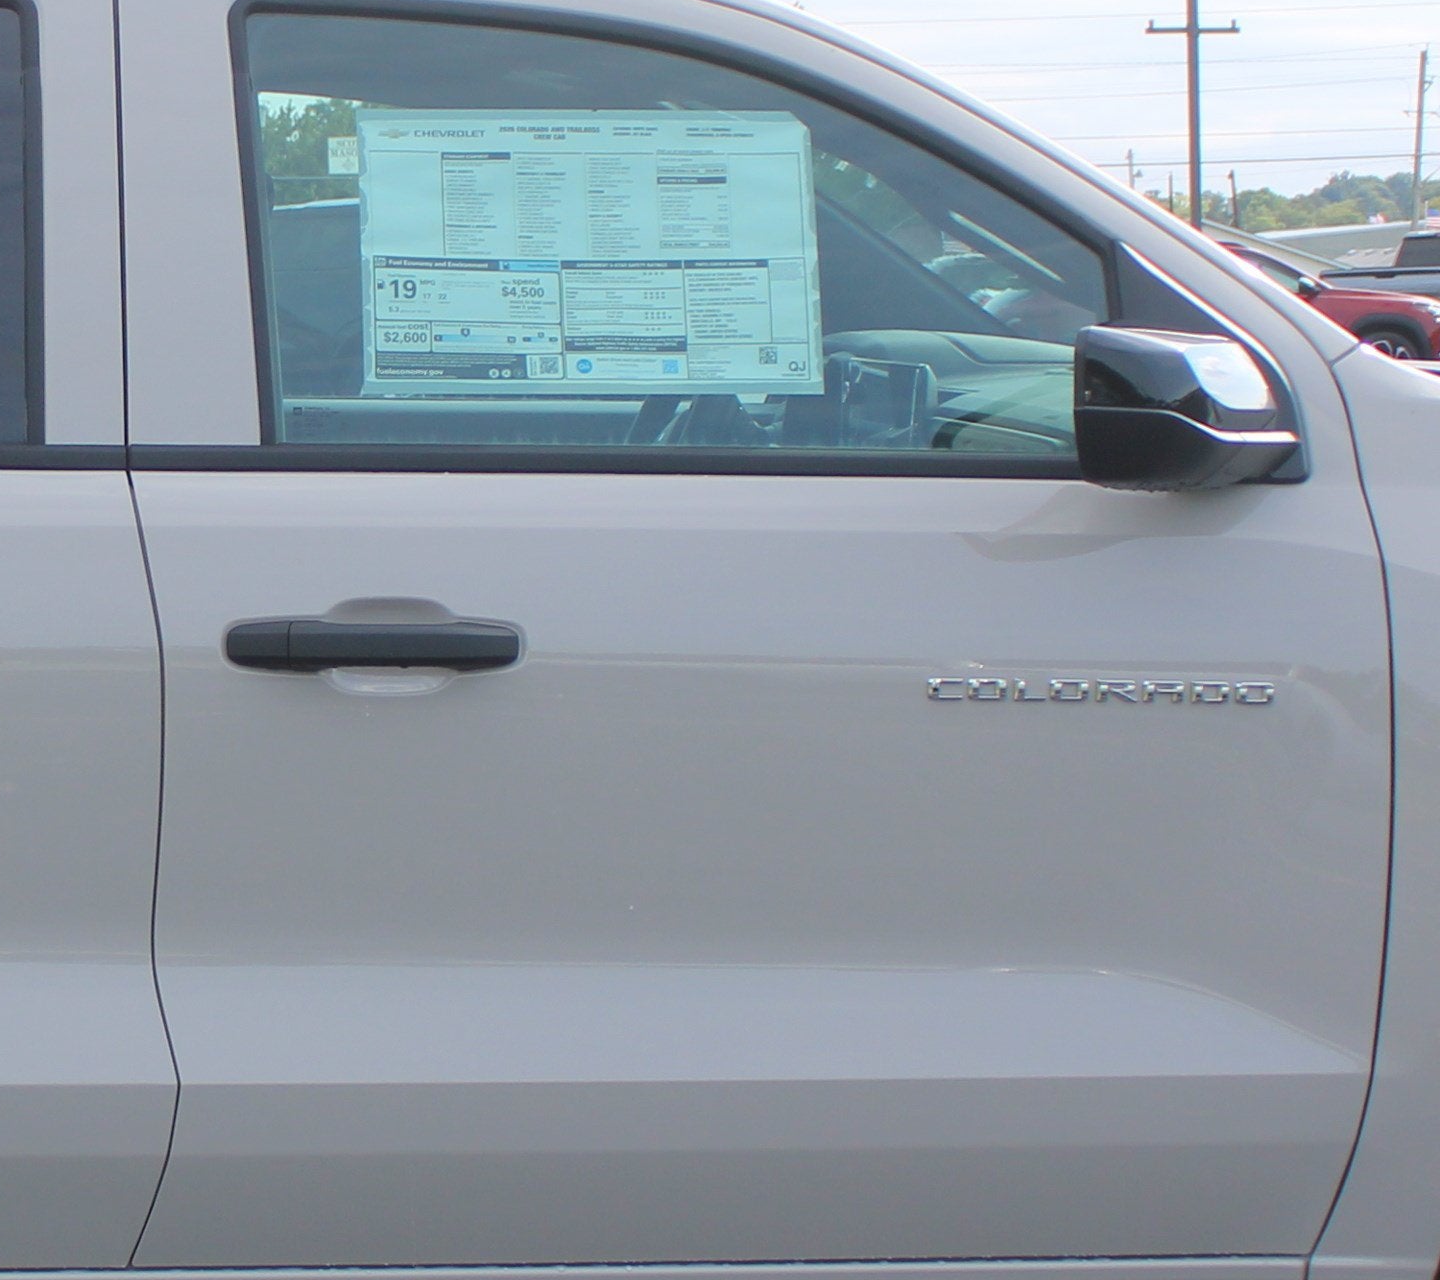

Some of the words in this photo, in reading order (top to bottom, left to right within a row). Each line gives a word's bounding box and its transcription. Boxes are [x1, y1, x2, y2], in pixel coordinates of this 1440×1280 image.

[414, 129, 486, 138] CHEVROLET
[389, 279, 417, 299] 19
[501, 286, 545, 298] $4,500
[383, 331, 428, 344] $2,600
[788, 361, 806, 371] QJ
[927, 677, 1275, 703] COLORADO
